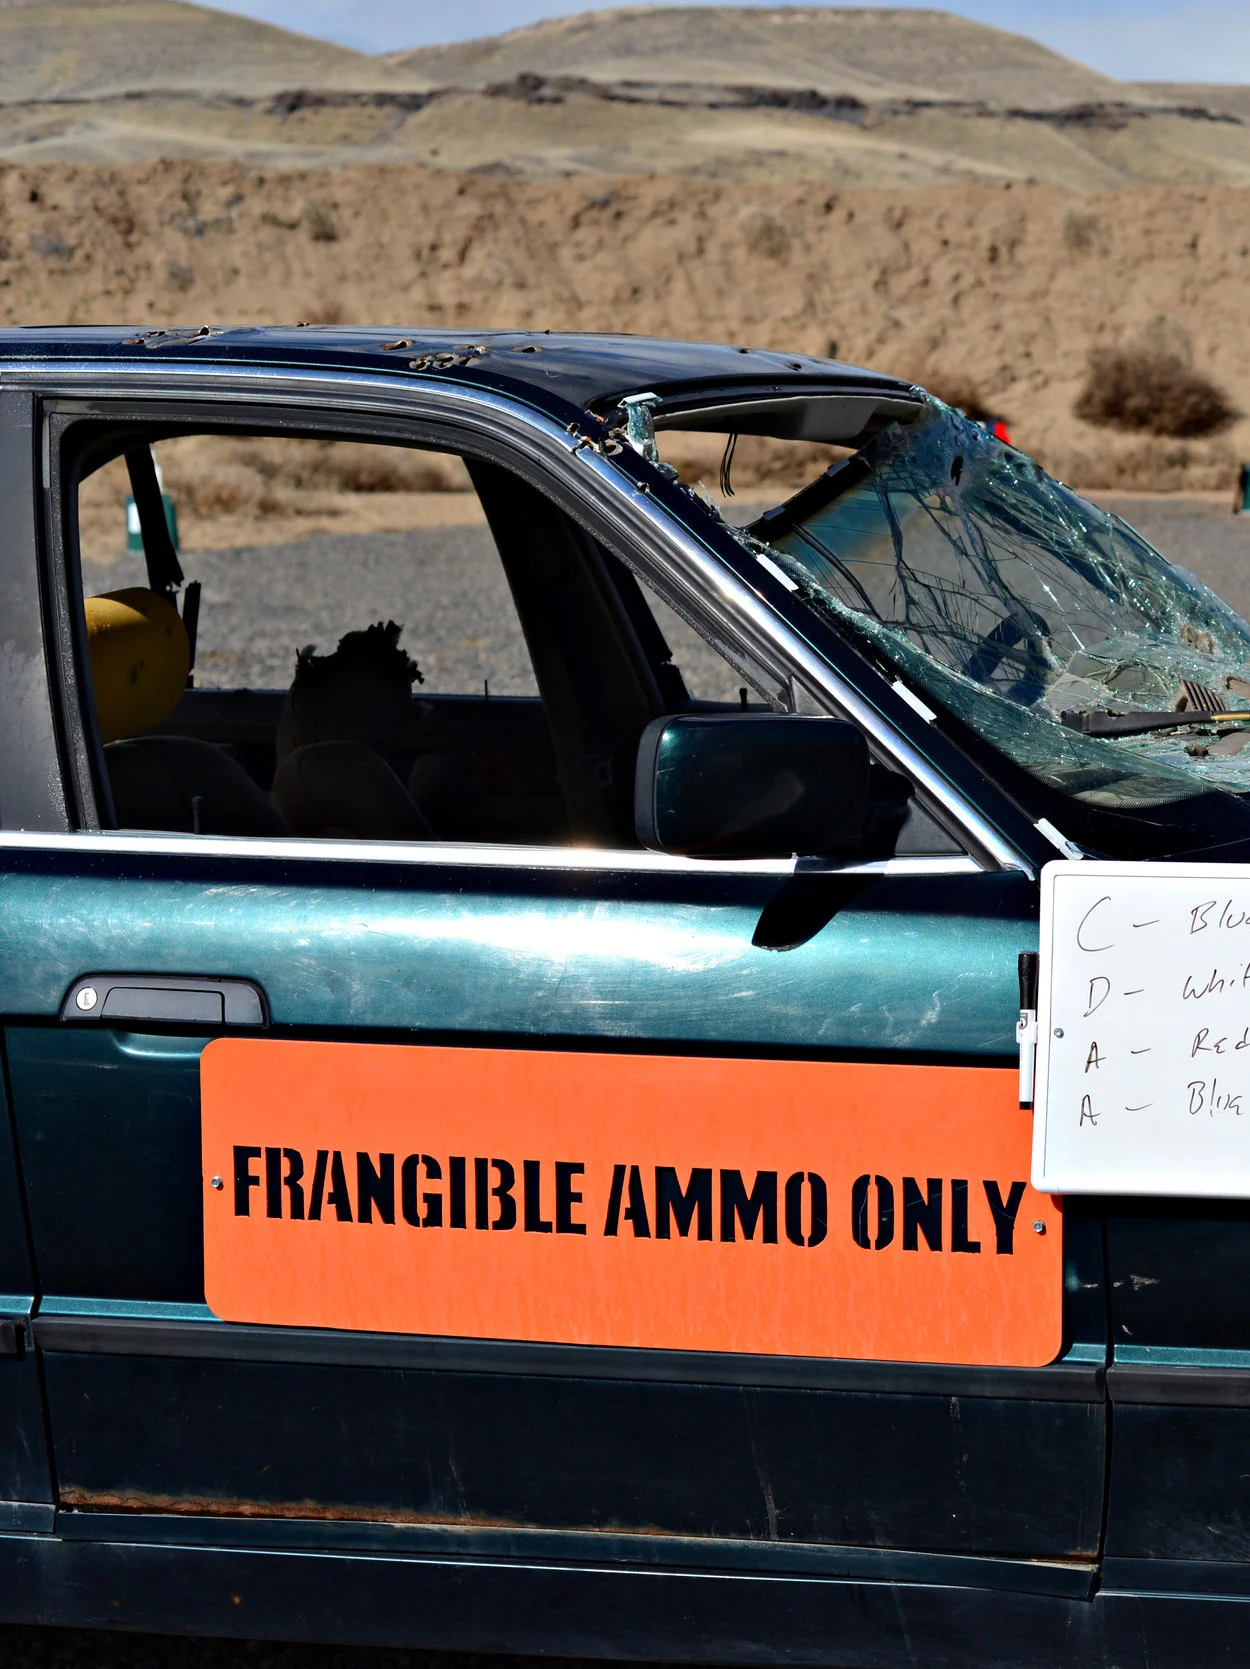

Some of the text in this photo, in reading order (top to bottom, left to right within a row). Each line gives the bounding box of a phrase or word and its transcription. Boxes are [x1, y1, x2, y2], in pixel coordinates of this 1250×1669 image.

[1077, 896, 1115, 952] C
[1083, 976, 1111, 1018] D
[1084, 1041, 1107, 1074] A
[1191, 1026, 1250, 1058] Red
[1079, 1094, 1101, 1127] A
[1187, 1077, 1244, 1117] Blue
[232, 1144, 1028, 1256] FRANGIBLE AMMO ONLY
